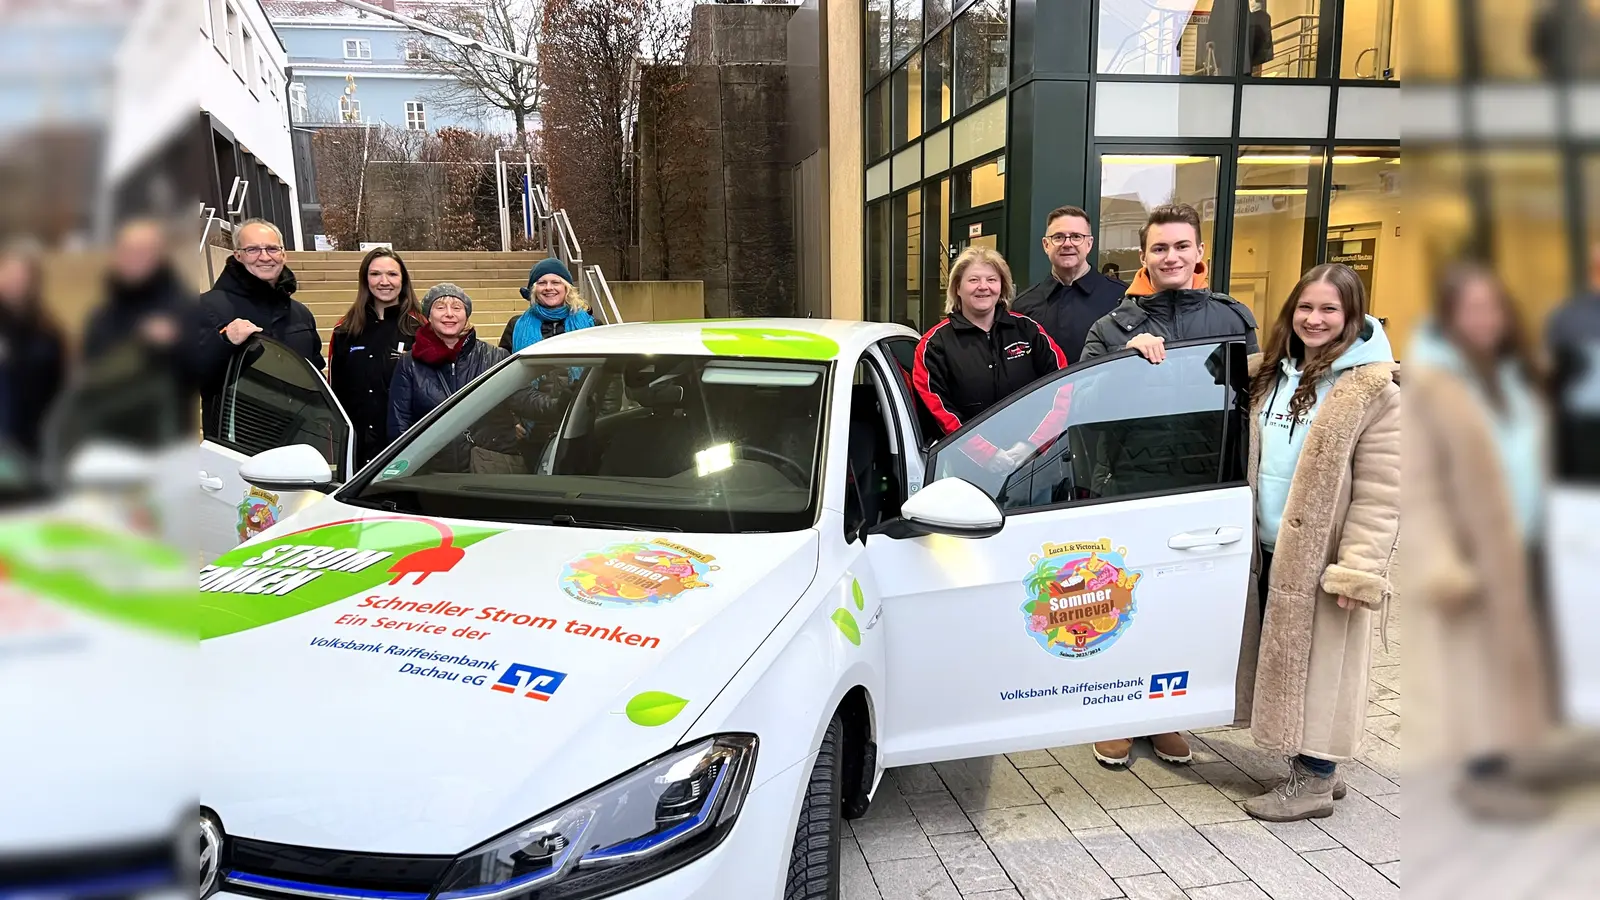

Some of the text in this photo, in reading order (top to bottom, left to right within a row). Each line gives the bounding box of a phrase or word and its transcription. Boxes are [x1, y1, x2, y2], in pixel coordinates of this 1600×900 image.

[243, 544, 394, 573] STROM
[1049, 547, 1063, 555] Luca
[1076, 543, 1101, 551] Victoria
[604, 558, 670, 583] Sommer
[1049, 588, 1112, 611] Sommer
[357, 595, 661, 649] Schneller Strom tanken
[1049, 600, 1115, 625] Karneval
[334, 614, 491, 641] Ein Service der
[309, 637, 500, 671] Volksbank Raiffeisenbank
[398, 662, 488, 686] Dachau eG
[1000, 677, 1144, 701] Volksbank Raiffeisenbank
[1082, 691, 1142, 706] Dachau eG
